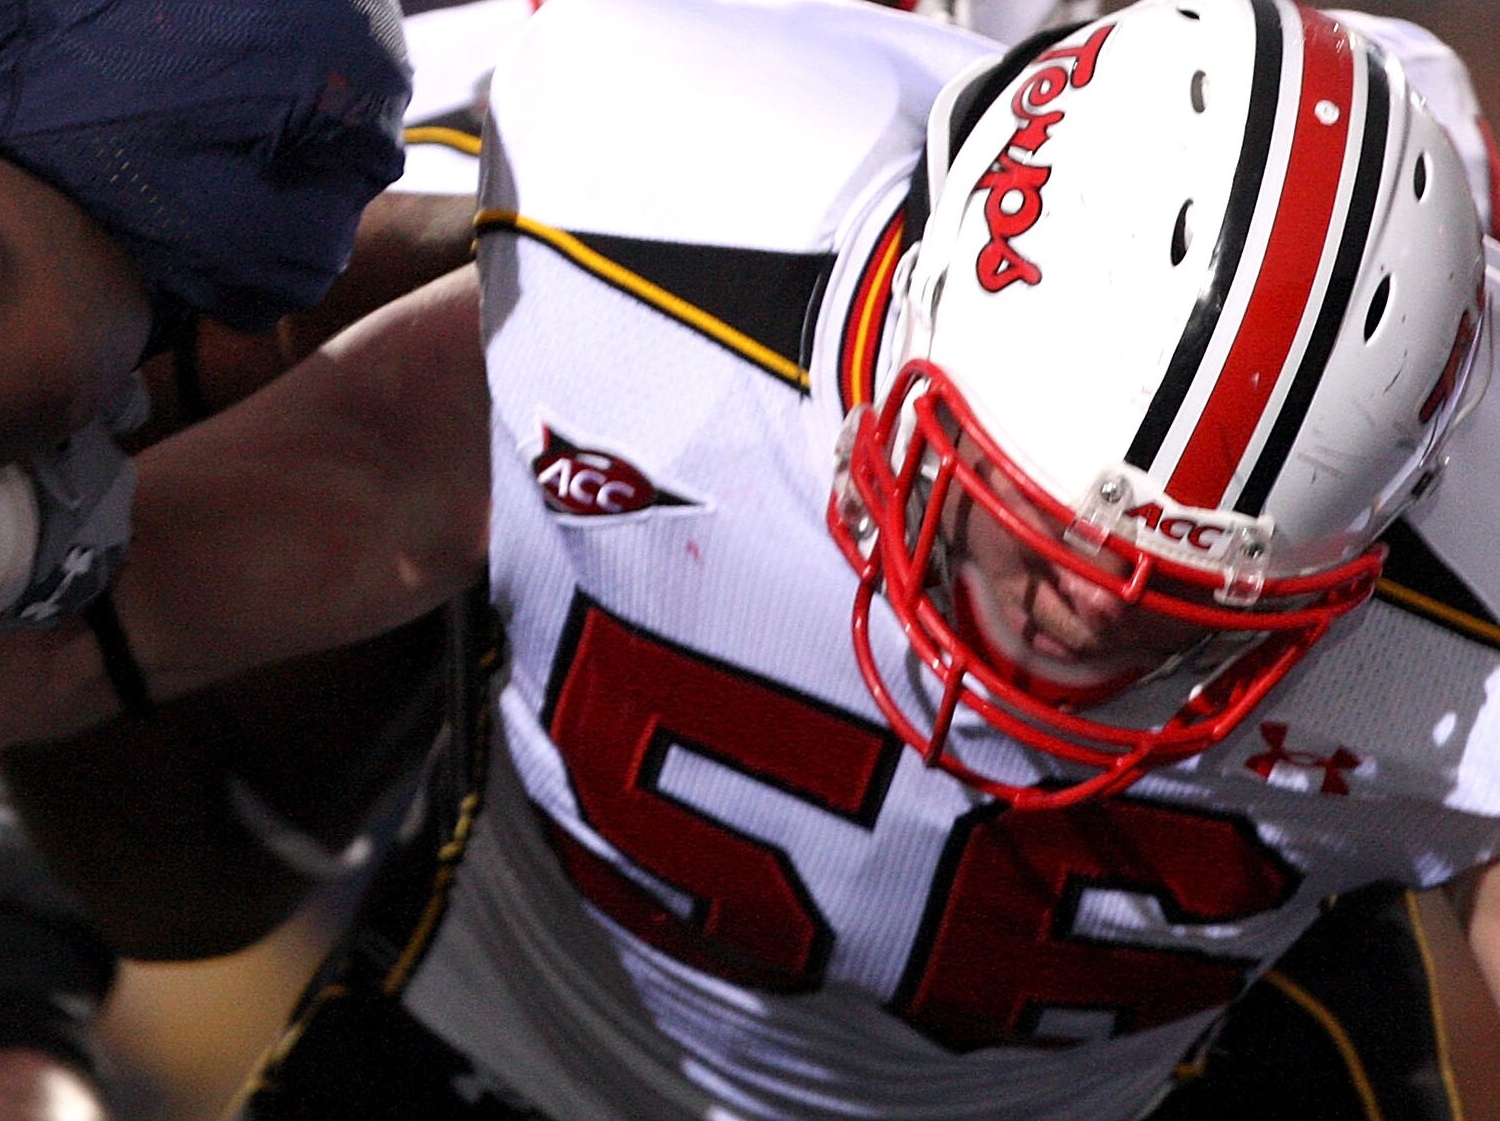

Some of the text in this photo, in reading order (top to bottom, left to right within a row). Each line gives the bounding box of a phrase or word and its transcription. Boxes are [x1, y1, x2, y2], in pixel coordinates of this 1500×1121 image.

[975, 21, 1117, 293] Terps
[537, 457, 636, 514] ACC
[1124, 502, 1226, 550] ACC
[540, 584, 1304, 1053] 56
